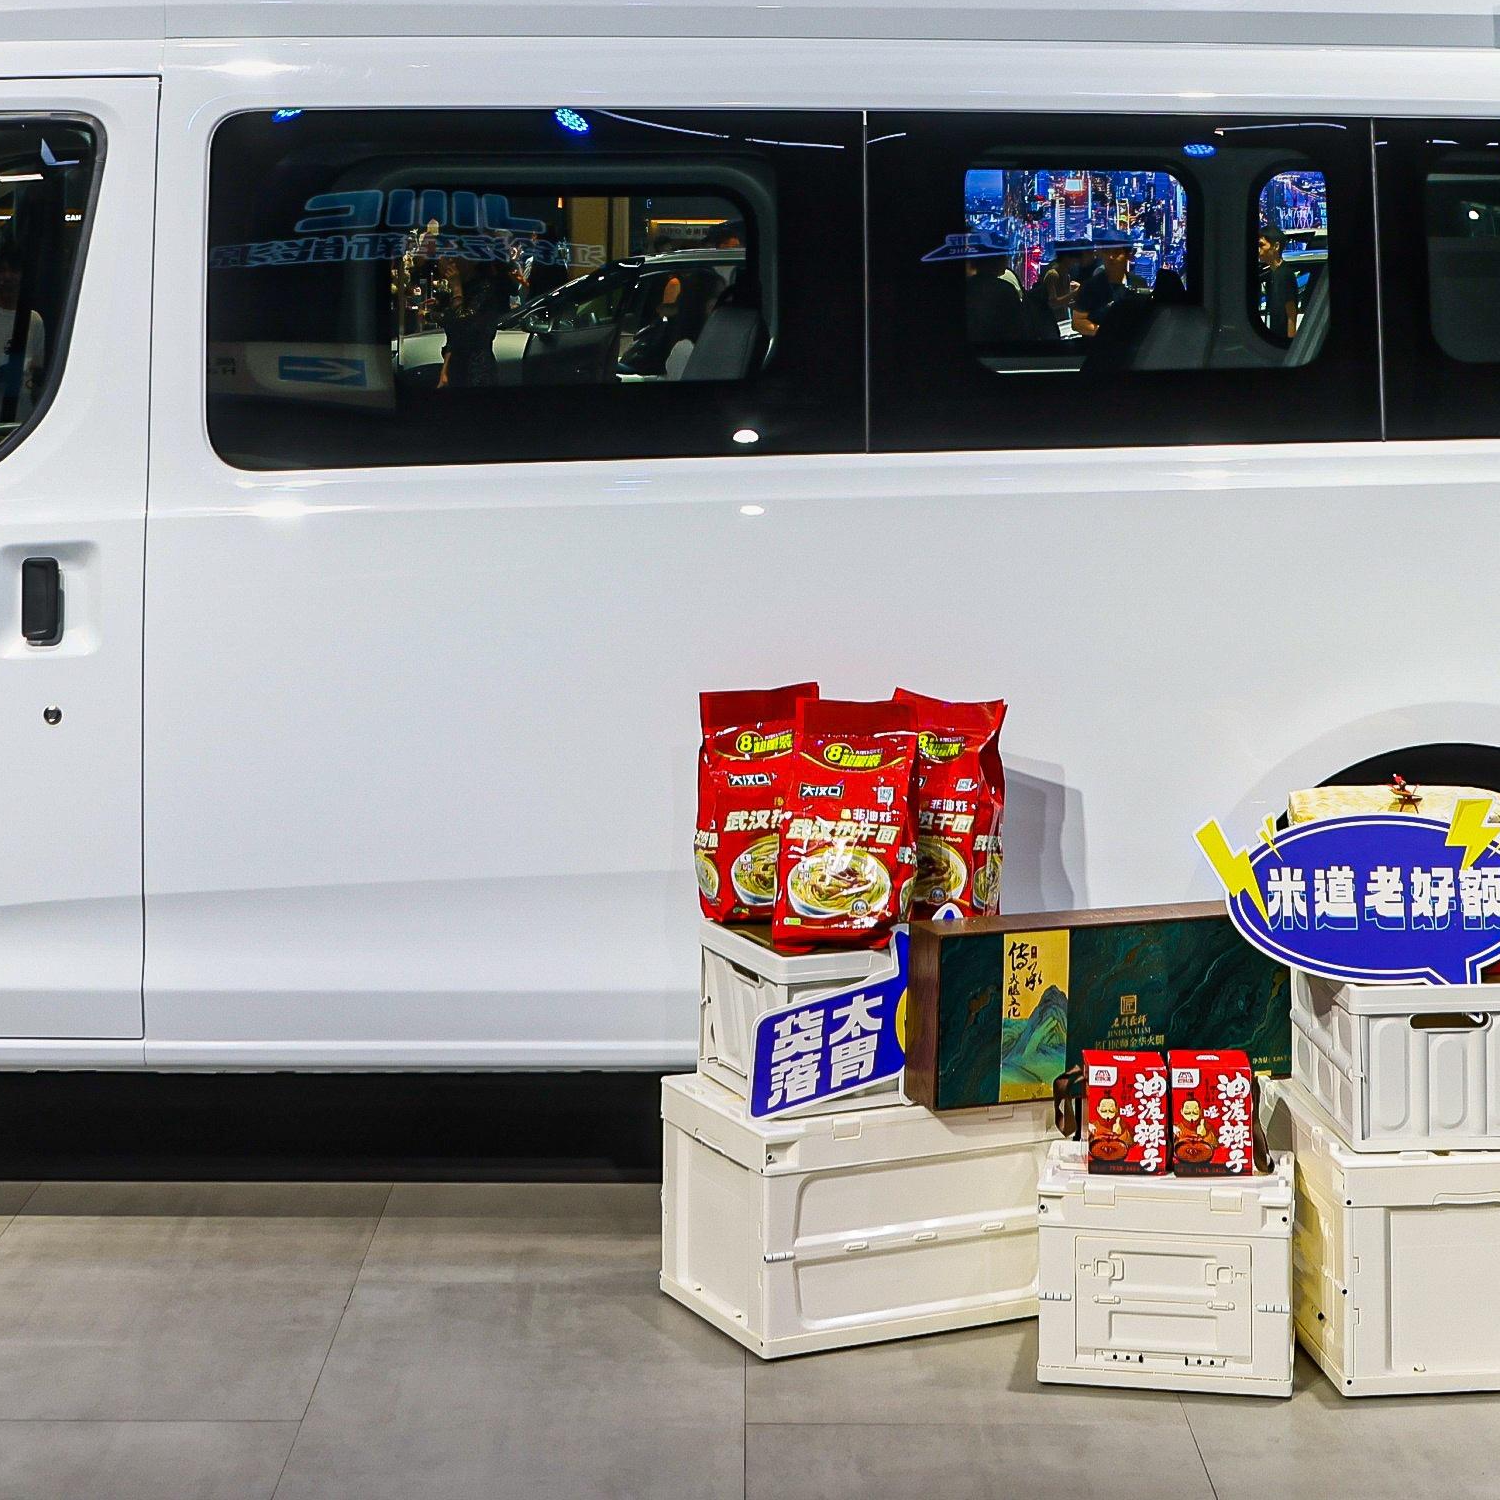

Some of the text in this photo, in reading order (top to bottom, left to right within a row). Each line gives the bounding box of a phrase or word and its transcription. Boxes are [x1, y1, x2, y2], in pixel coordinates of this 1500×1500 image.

[785, 817, 901, 845] 武汉热干面
